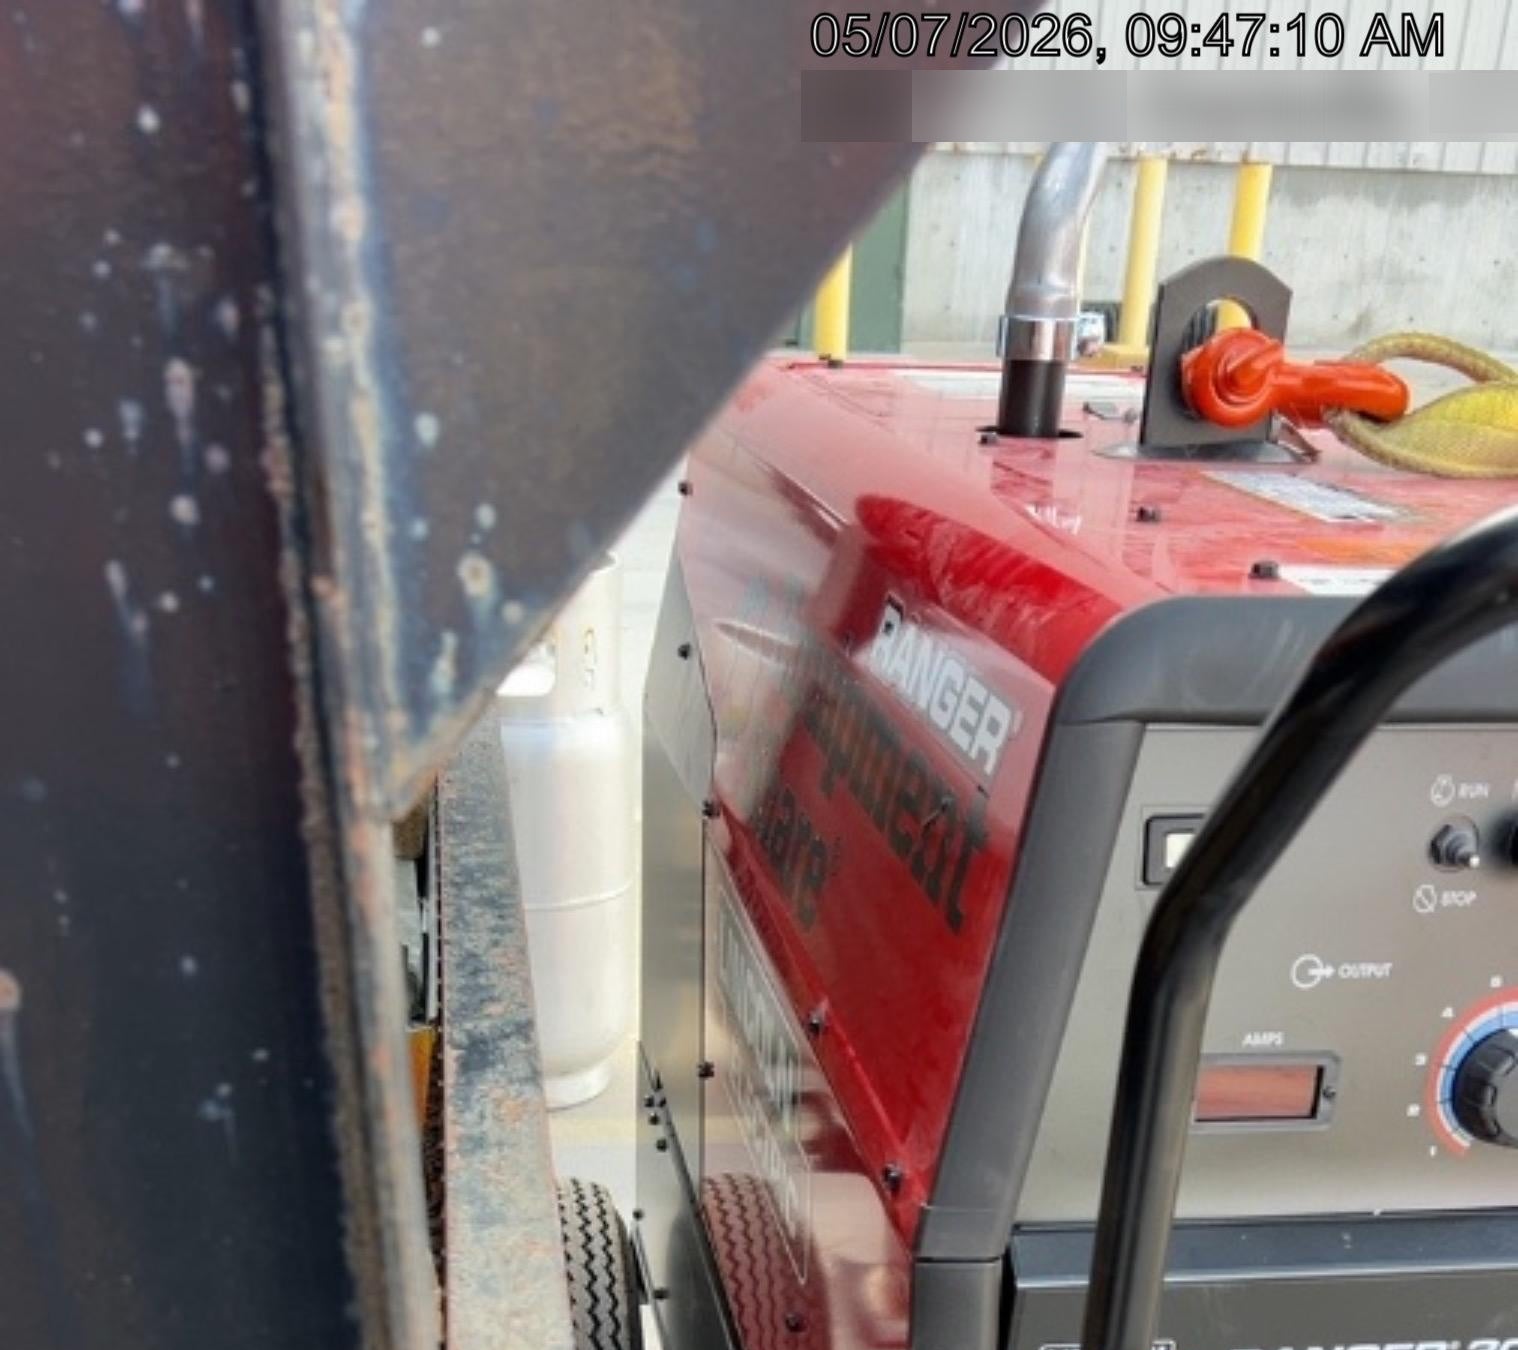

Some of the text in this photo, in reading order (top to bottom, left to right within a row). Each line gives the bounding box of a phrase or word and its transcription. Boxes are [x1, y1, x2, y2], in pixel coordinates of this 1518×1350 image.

[869, 594, 1012, 777] RANGER
[1338, 962, 1393, 979] OUTPUT
[1242, 1031, 1285, 1047] AMPS
